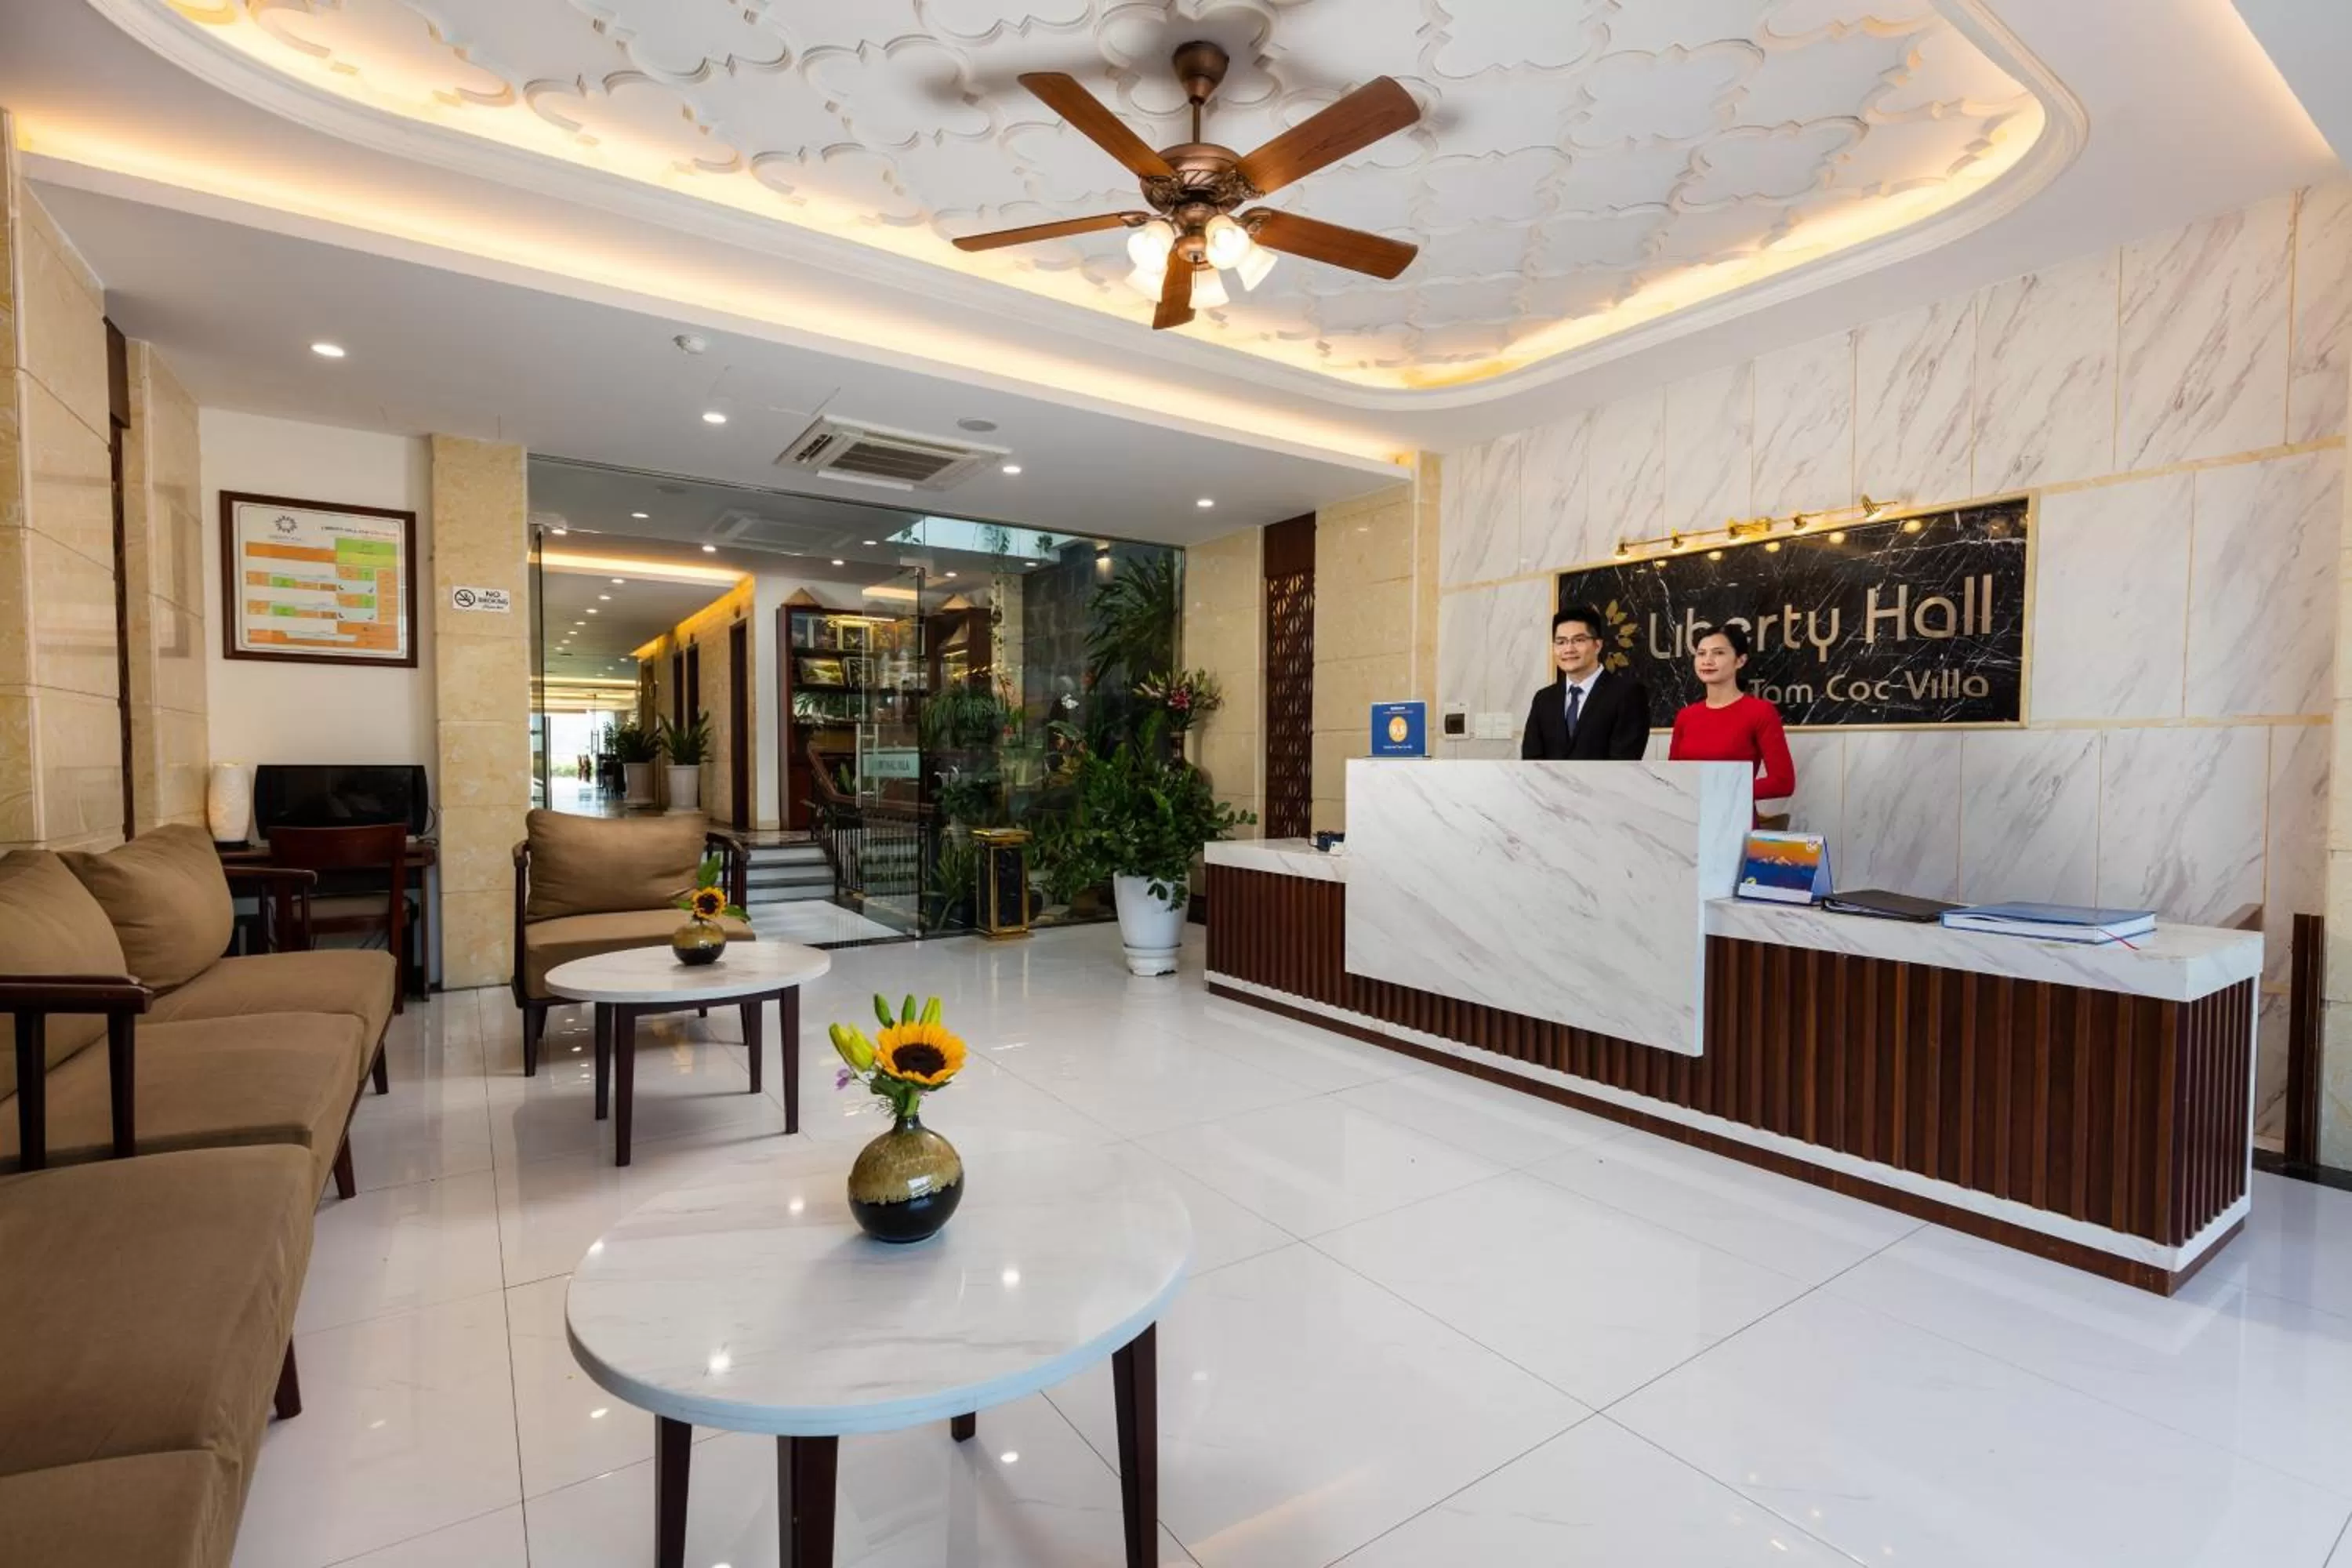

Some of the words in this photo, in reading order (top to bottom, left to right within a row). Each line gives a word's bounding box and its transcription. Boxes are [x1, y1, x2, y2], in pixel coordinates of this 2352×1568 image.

[1867, 573, 1993, 644] Hall
[1748, 678, 1813, 704] Tam
[1827, 674, 1889, 702] Coc
[1905, 668, 1990, 700] Villa
